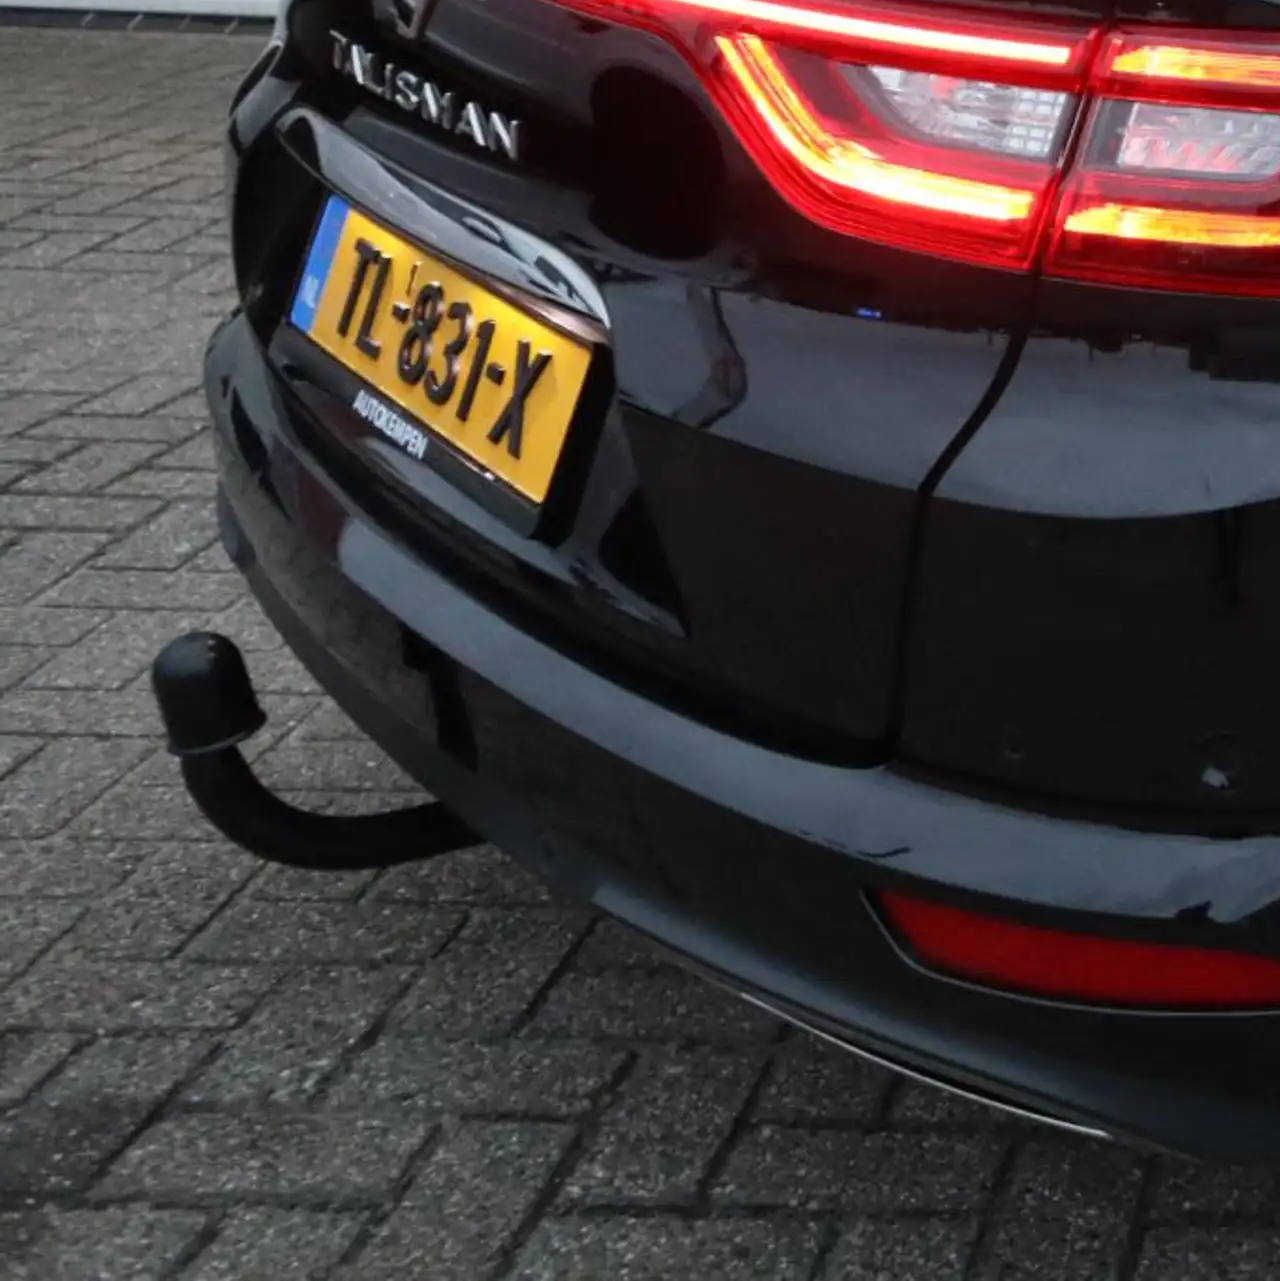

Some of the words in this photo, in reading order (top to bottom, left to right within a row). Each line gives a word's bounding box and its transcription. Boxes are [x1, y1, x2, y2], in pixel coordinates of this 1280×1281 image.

[329, 29, 521, 161] TALISMAN
[336, 237, 554, 460] TL-831-X
[353, 388, 429, 461] AUTOKEMPEN
